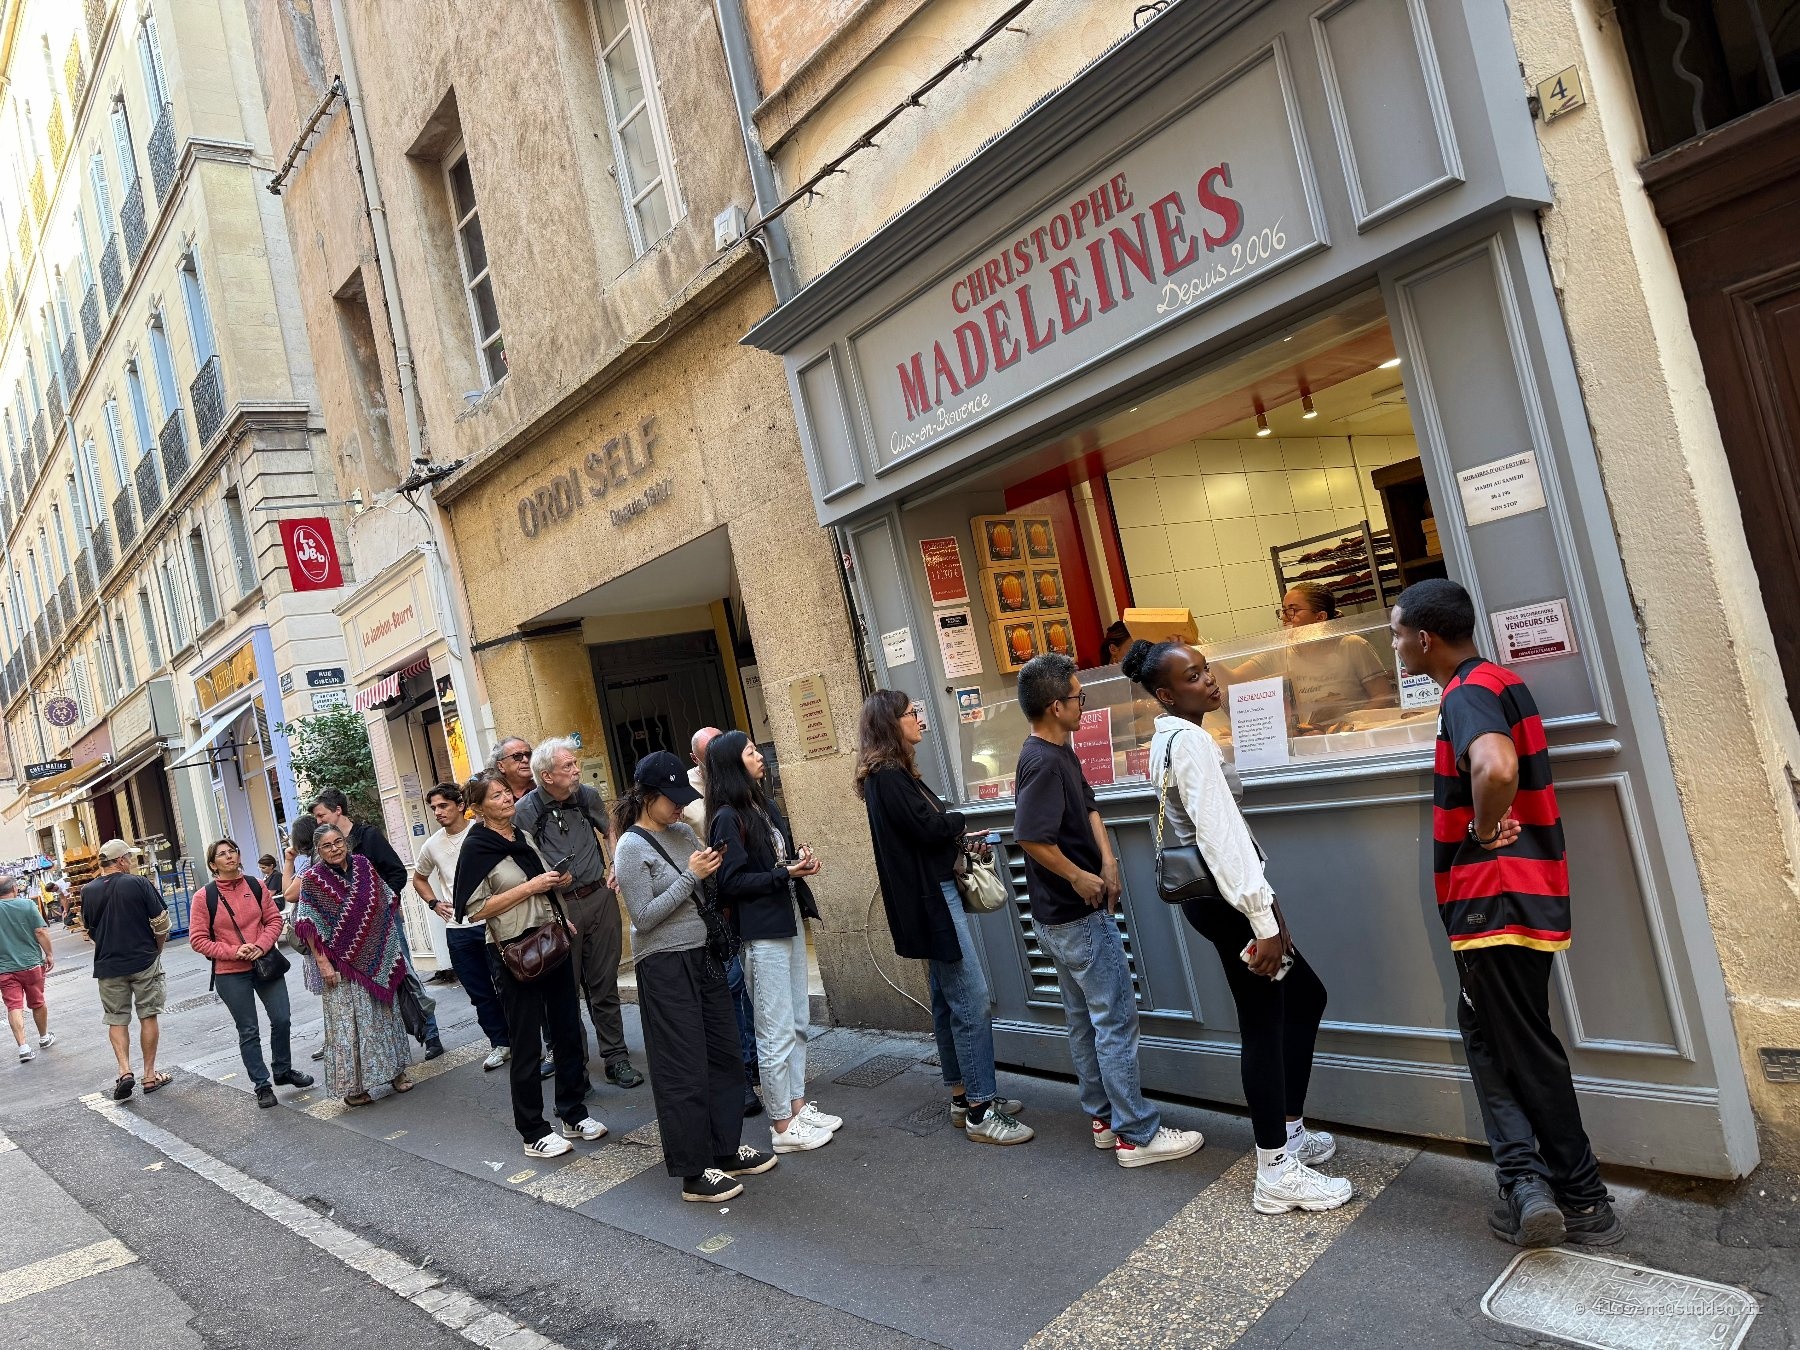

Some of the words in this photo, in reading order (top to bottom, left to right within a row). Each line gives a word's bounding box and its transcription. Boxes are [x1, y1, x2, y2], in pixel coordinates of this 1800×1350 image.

[1550, 76, 1568, 101] 4
[951, 172, 1134, 314] CHRISTOPHE
[1156, 264, 1227, 315] Depuis
[1229, 215, 1287, 275] 2006
[896, 162, 1245, 422] MADELEINES
[518, 466, 584, 538] ORDI
[583, 414, 657, 498] SELF
[1474, 482, 1493, 492] MARDI
[1502, 473, 1524, 484] SAMEDI
[1490, 504, 1502, 512] NON
[1503, 500, 1518, 509] STOP
[299, 529, 316, 547] Le
[1505, 614, 1559, 631] VENDEURS/SES
[318, 670, 333, 678] RUE
[1080, 712, 1103, 724] ARIFS
